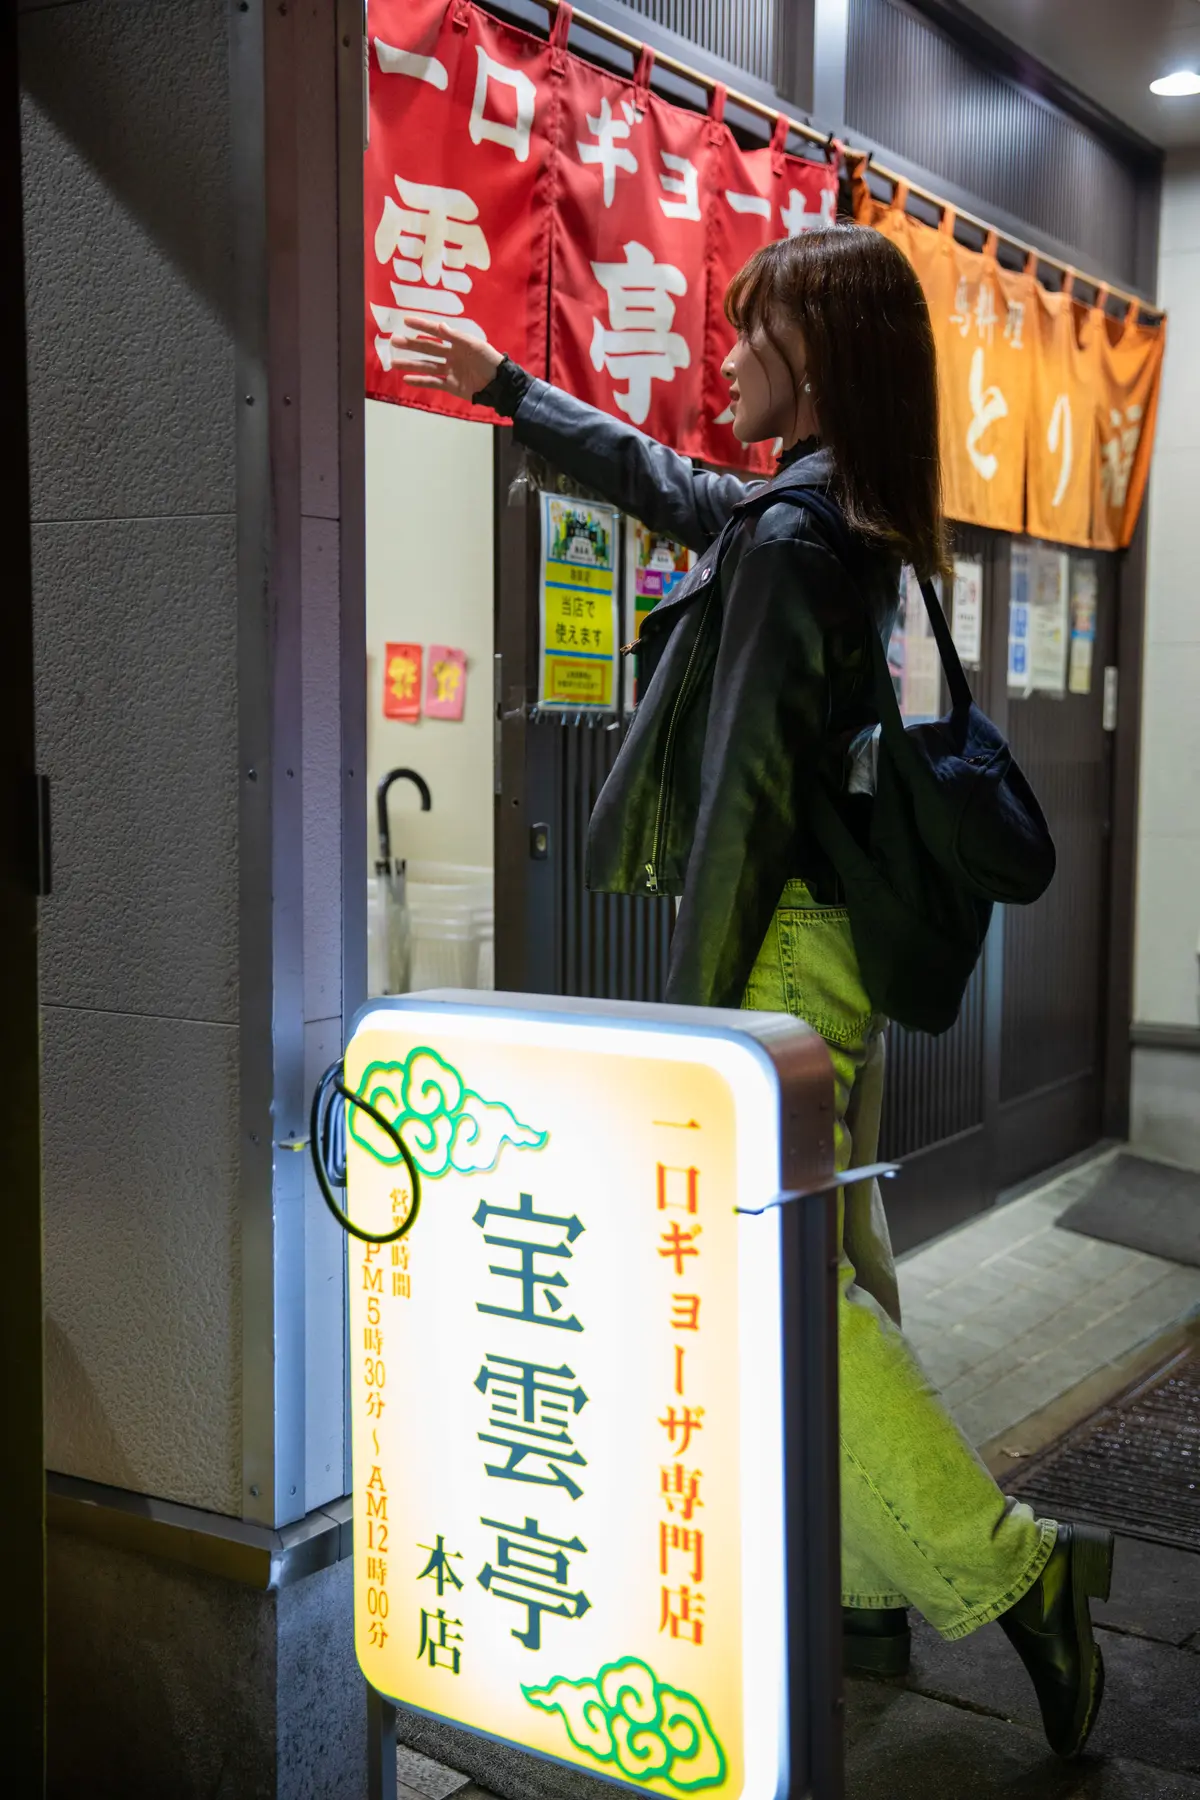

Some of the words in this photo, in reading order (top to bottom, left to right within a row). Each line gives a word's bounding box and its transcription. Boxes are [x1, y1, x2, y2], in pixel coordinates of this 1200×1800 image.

[555, 621, 602, 647] 使えます
[561, 595, 596, 618] 当店で
[471, 1192, 592, 1652] 宝雲亭
[651, 1117, 706, 1648] 一口ギョーザ専門店
[415, 1533, 465, 1676] 本店
